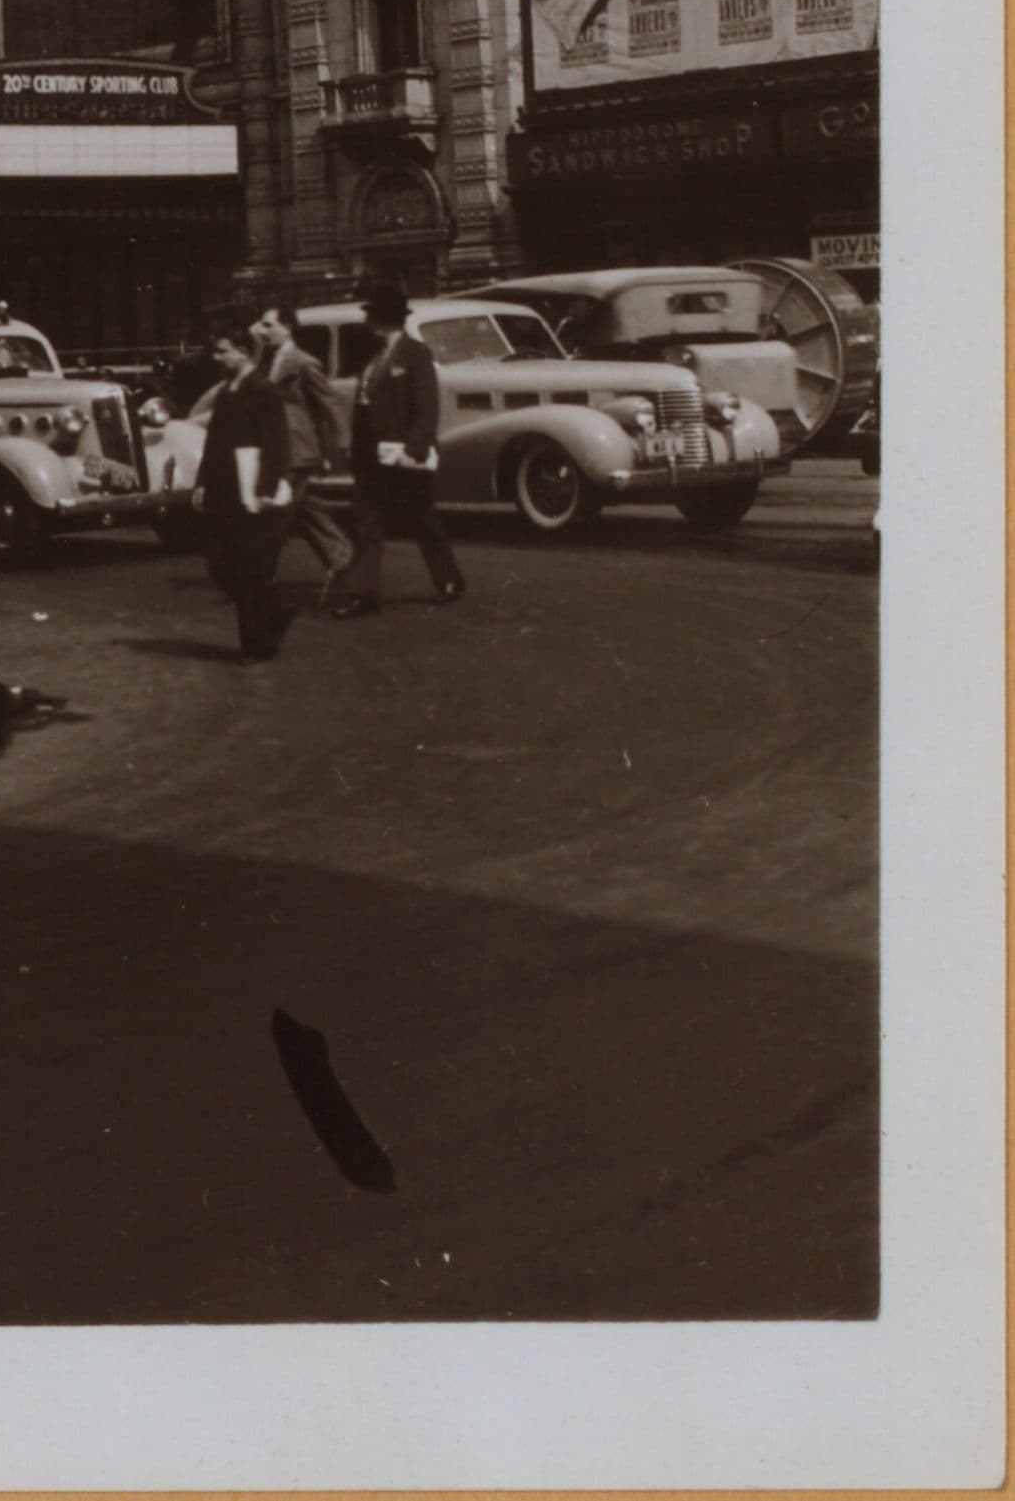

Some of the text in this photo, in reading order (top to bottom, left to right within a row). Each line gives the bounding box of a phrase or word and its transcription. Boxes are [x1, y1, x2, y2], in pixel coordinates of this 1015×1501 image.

[33, 74, 86, 93] CENTURY
[89, 74, 147, 94] SPORTING
[149, 76, 179, 94] CLUB
[528, 124, 753, 176] SANDWICH SHOP
